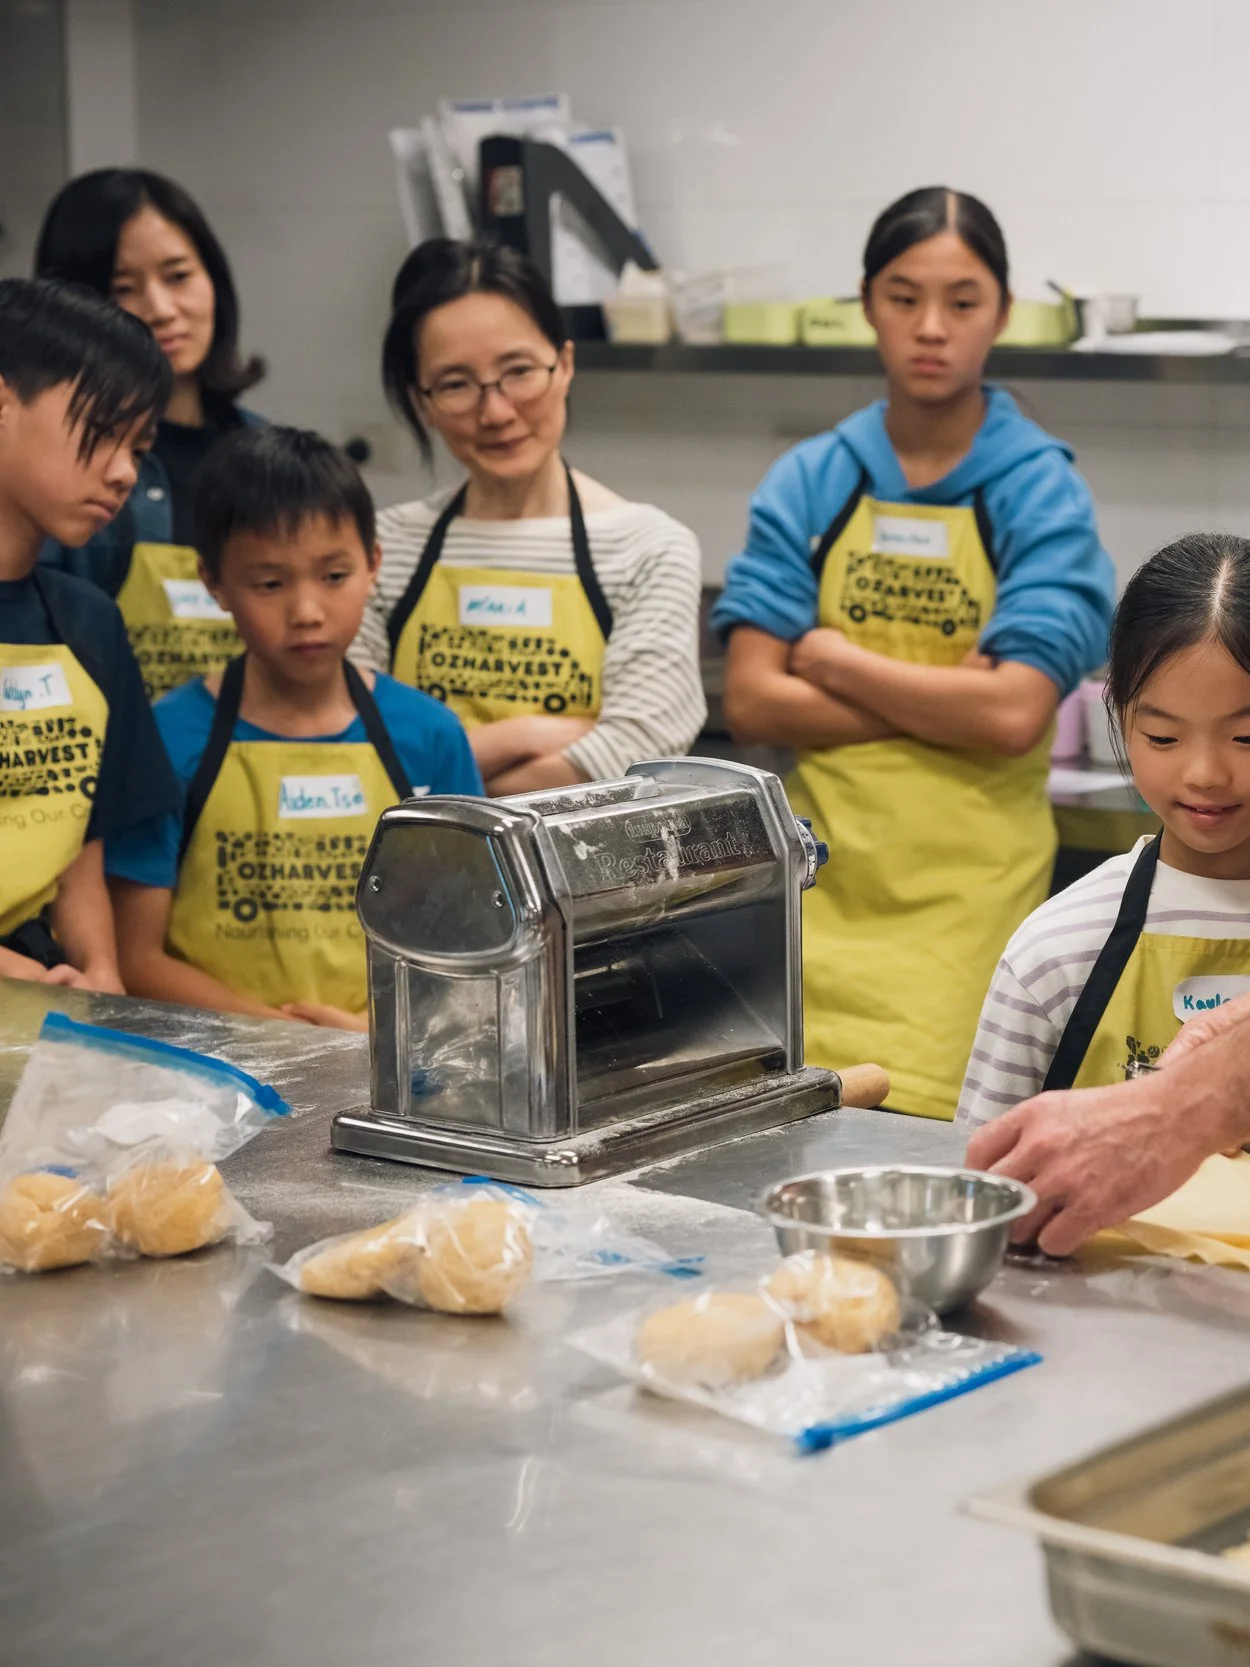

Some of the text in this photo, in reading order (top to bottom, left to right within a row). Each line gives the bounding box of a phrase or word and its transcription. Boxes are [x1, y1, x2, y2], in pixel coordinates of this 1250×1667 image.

[432, 652, 563, 677] OZHARVEST
[30, 807, 64, 825] Our
[593, 831, 742, 882] Restaurant
[237, 862, 361, 881] OZHARVES
